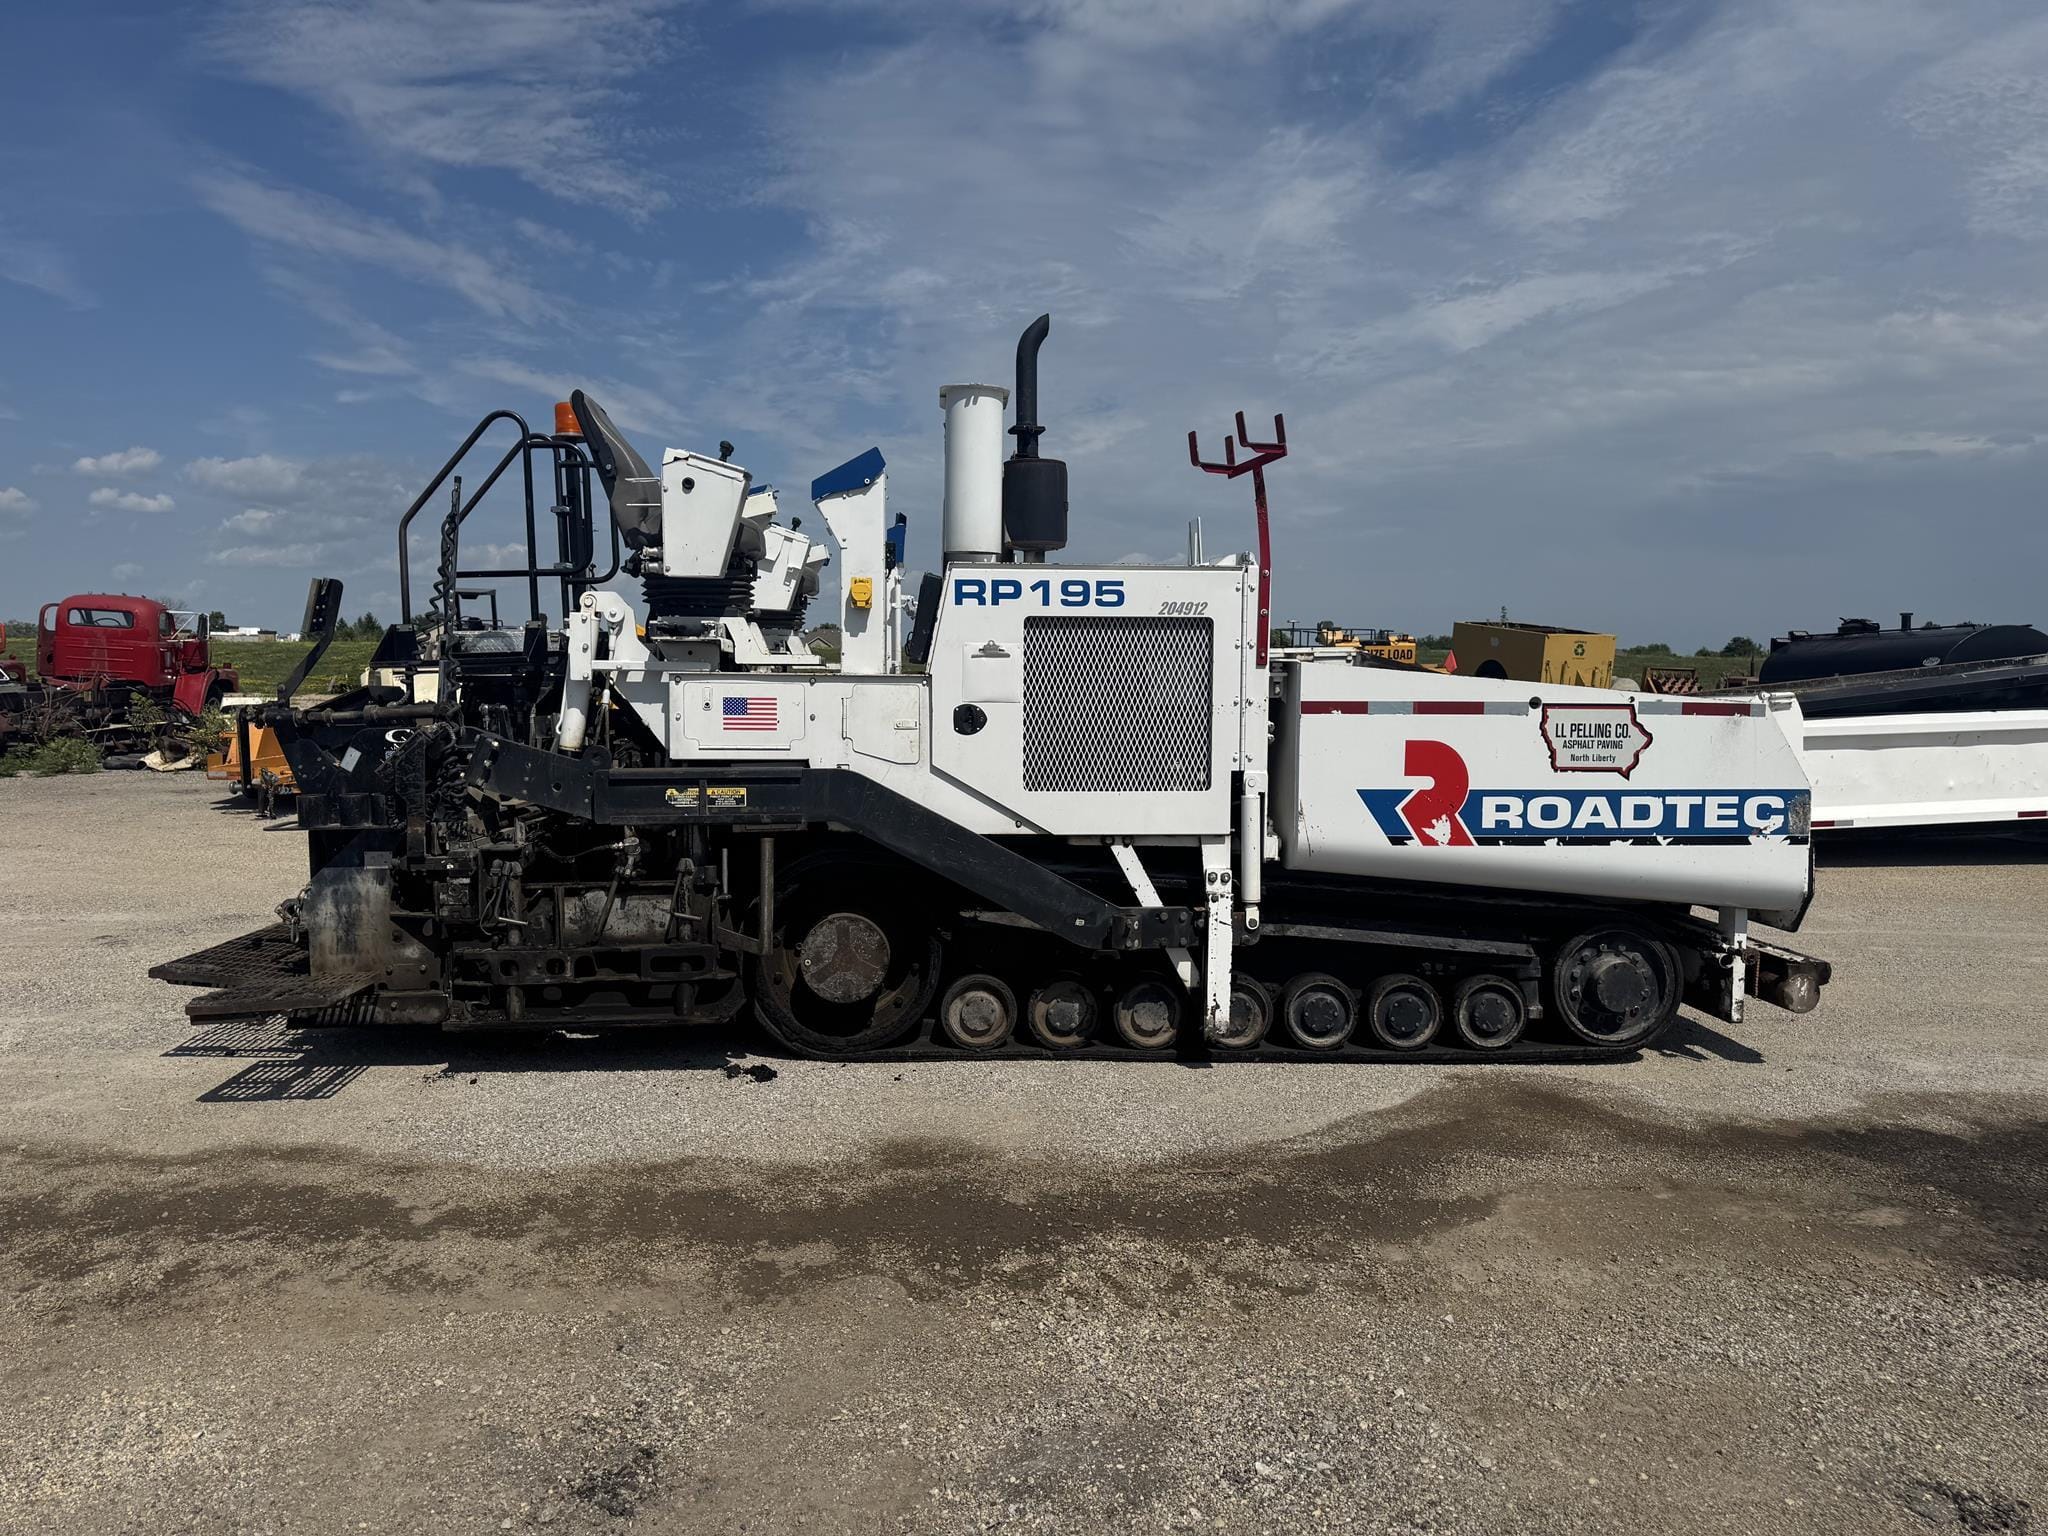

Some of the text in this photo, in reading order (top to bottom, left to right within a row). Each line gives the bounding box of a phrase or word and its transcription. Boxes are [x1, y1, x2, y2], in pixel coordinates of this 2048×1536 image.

[954, 579, 1126, 608] RP195
[1158, 601, 1209, 616] 204912
[1388, 649, 1413, 660] LOAD
[1555, 722, 1631, 739] LL PELLING CO.
[1562, 739, 1624, 750] ASPHALT PAVING
[1570, 753, 1616, 764] North Liberty
[1481, 795, 1786, 831] ROADTEC
